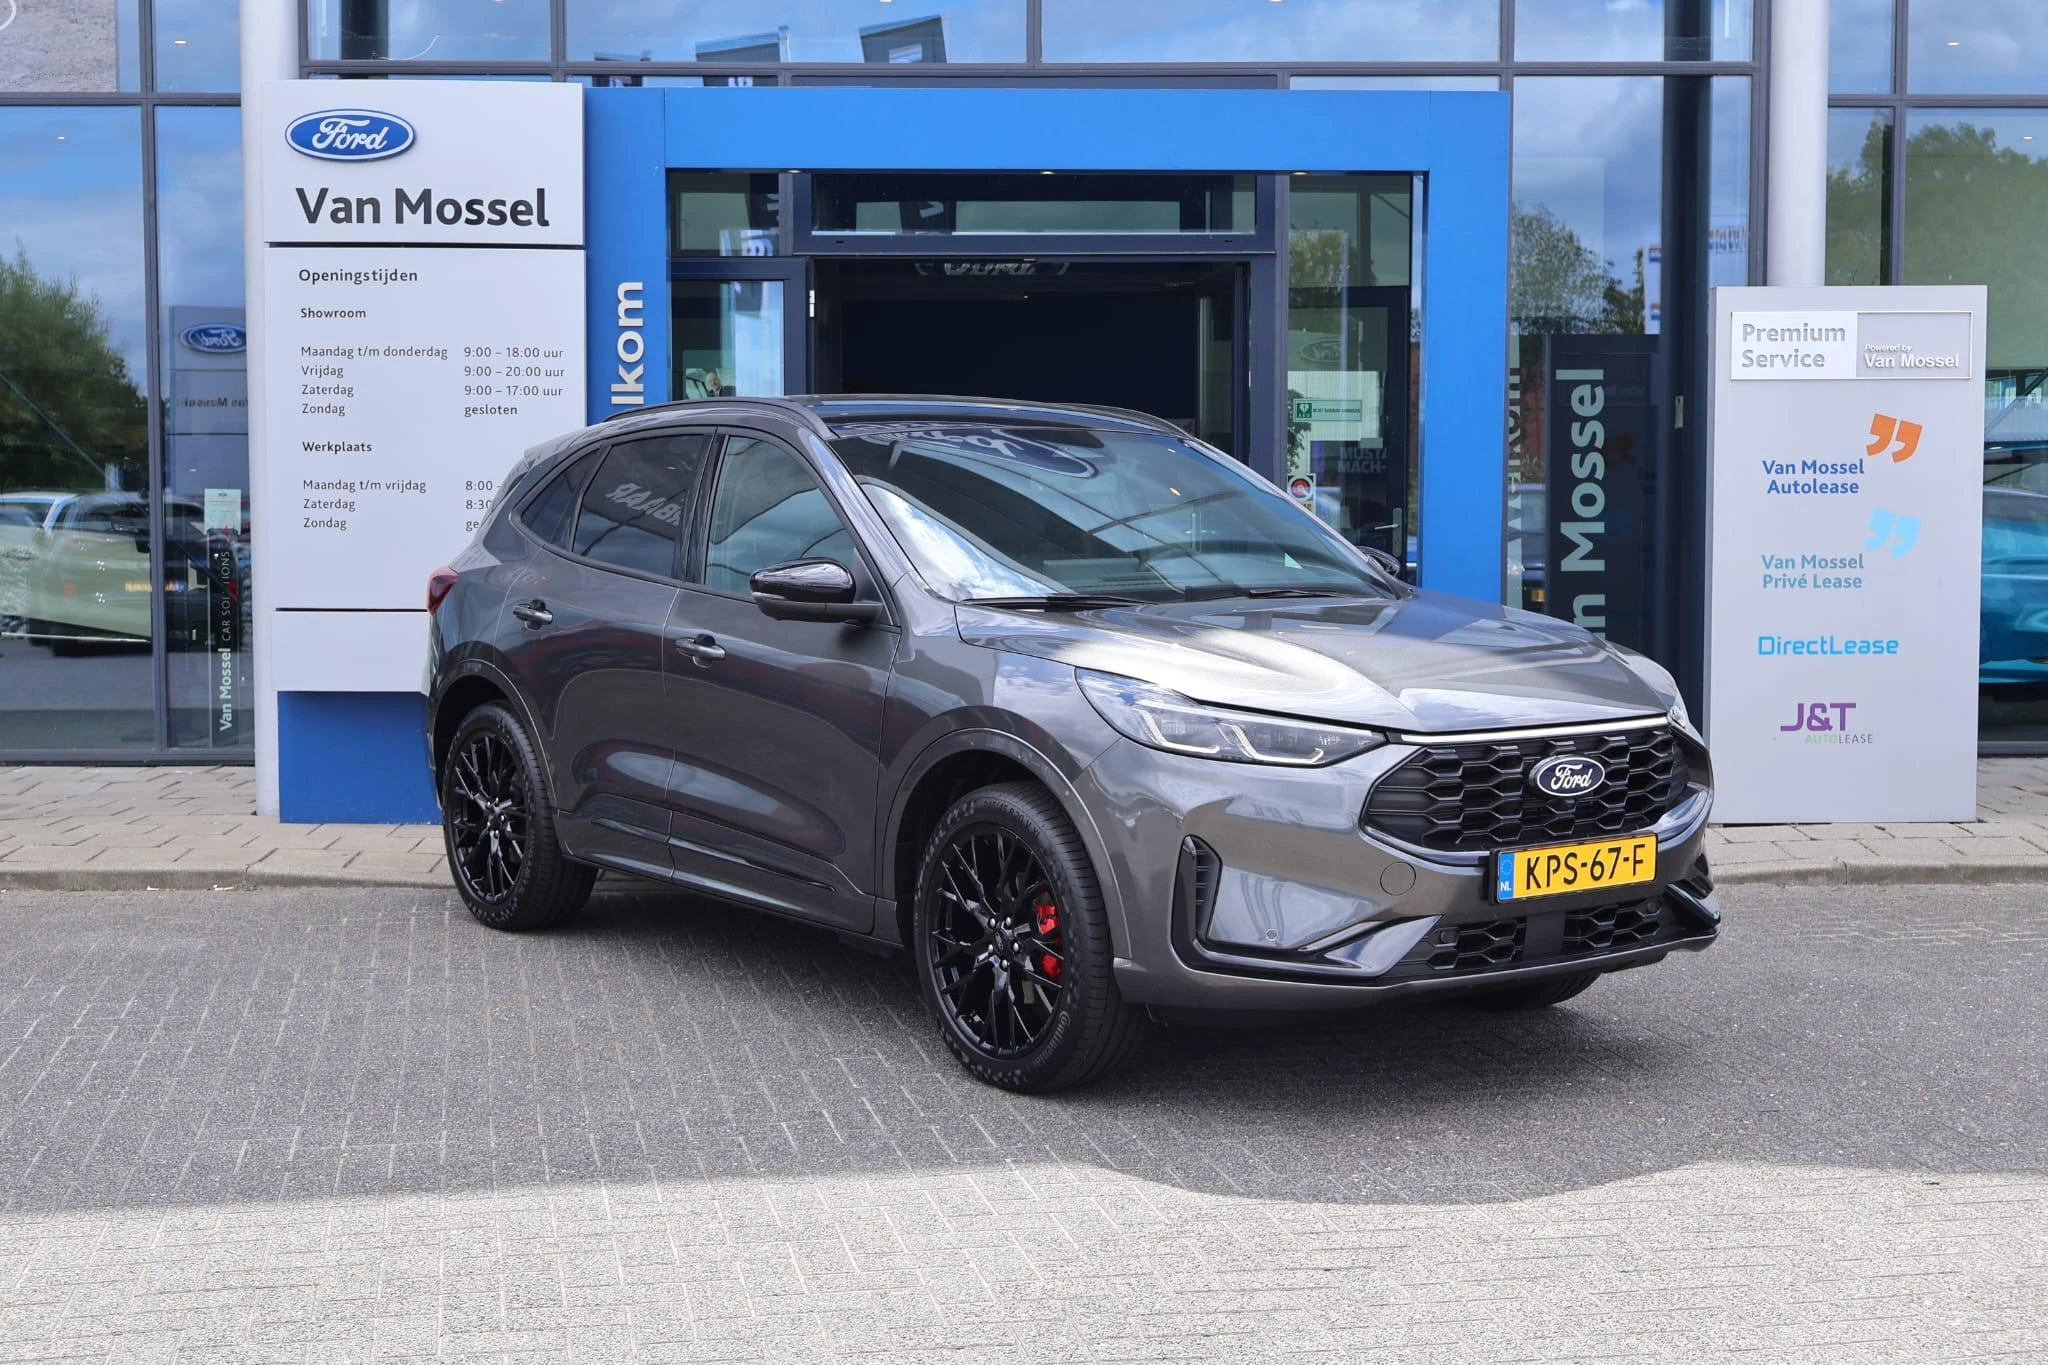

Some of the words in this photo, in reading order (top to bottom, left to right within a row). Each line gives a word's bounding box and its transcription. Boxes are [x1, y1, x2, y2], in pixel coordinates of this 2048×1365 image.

[311, 117, 389, 149] Ford
[295, 187, 381, 225] Van
[394, 187, 550, 228] Mossel
[298, 268, 418, 286] Openingstijden
[300, 307, 367, 319] Showroom
[1740, 321, 1849, 344] Premium
[301, 345, 354, 360] Maandag
[357, 345, 380, 357] t/m
[383, 345, 448, 361] donderdag
[463, 346, 492, 358] 9:00
[505, 347, 540, 358] 18:00
[543, 350, 564, 359] uur
[1863, 343, 1899, 355] Powered
[1901, 344, 1913, 355] by
[1741, 349, 1826, 369] Service
[1864, 353, 1896, 370] Van
[1899, 353, 1961, 370] Mossel
[301, 364, 344, 379] Vrijdag
[463, 365, 492, 377] 9:00
[505, 366, 542, 377] 20:00
[545, 369, 566, 377] uur
[301, 383, 354, 398] Zaterdag
[464, 385, 492, 396] 9:00
[505, 385, 539, 396] 17:00
[542, 388, 564, 397] uur
[301, 402, 346, 417] Zondag
[464, 403, 518, 418] gesloten
[302, 440, 372, 455] Werkplaats
[1555, 368, 1606, 572] Mossel
[1761, 459, 1796, 474] Van
[1801, 459, 1865, 475] Mossel
[303, 479, 356, 494] Maandag
[359, 479, 382, 490] t/m
[385, 479, 427, 494] vrijdag
[465, 480, 493, 491] 8:00
[1767, 479, 1860, 495] Autolease
[303, 497, 356, 513] Zaterdag
[303, 516, 347, 532] Zondag
[1761, 554, 1796, 569] Van
[1801, 553, 1865, 569] Mossel
[1762, 574, 1808, 589] Privé
[1812, 574, 1863, 589] Lease
[1573, 594, 1606, 640] n
[221, 619, 232, 642] CAR
[1758, 636, 1899, 655] DirectLease
[218, 649, 232, 699] Mossel
[220, 704, 232, 732] Van
[1780, 703, 1857, 731] J&T
[1804, 734, 1873, 744] AUTOLEASE
[1550, 764, 1593, 790] Ford
[1525, 843, 1646, 891] KPS-67-F
[1500, 881, 1512, 892] NL
